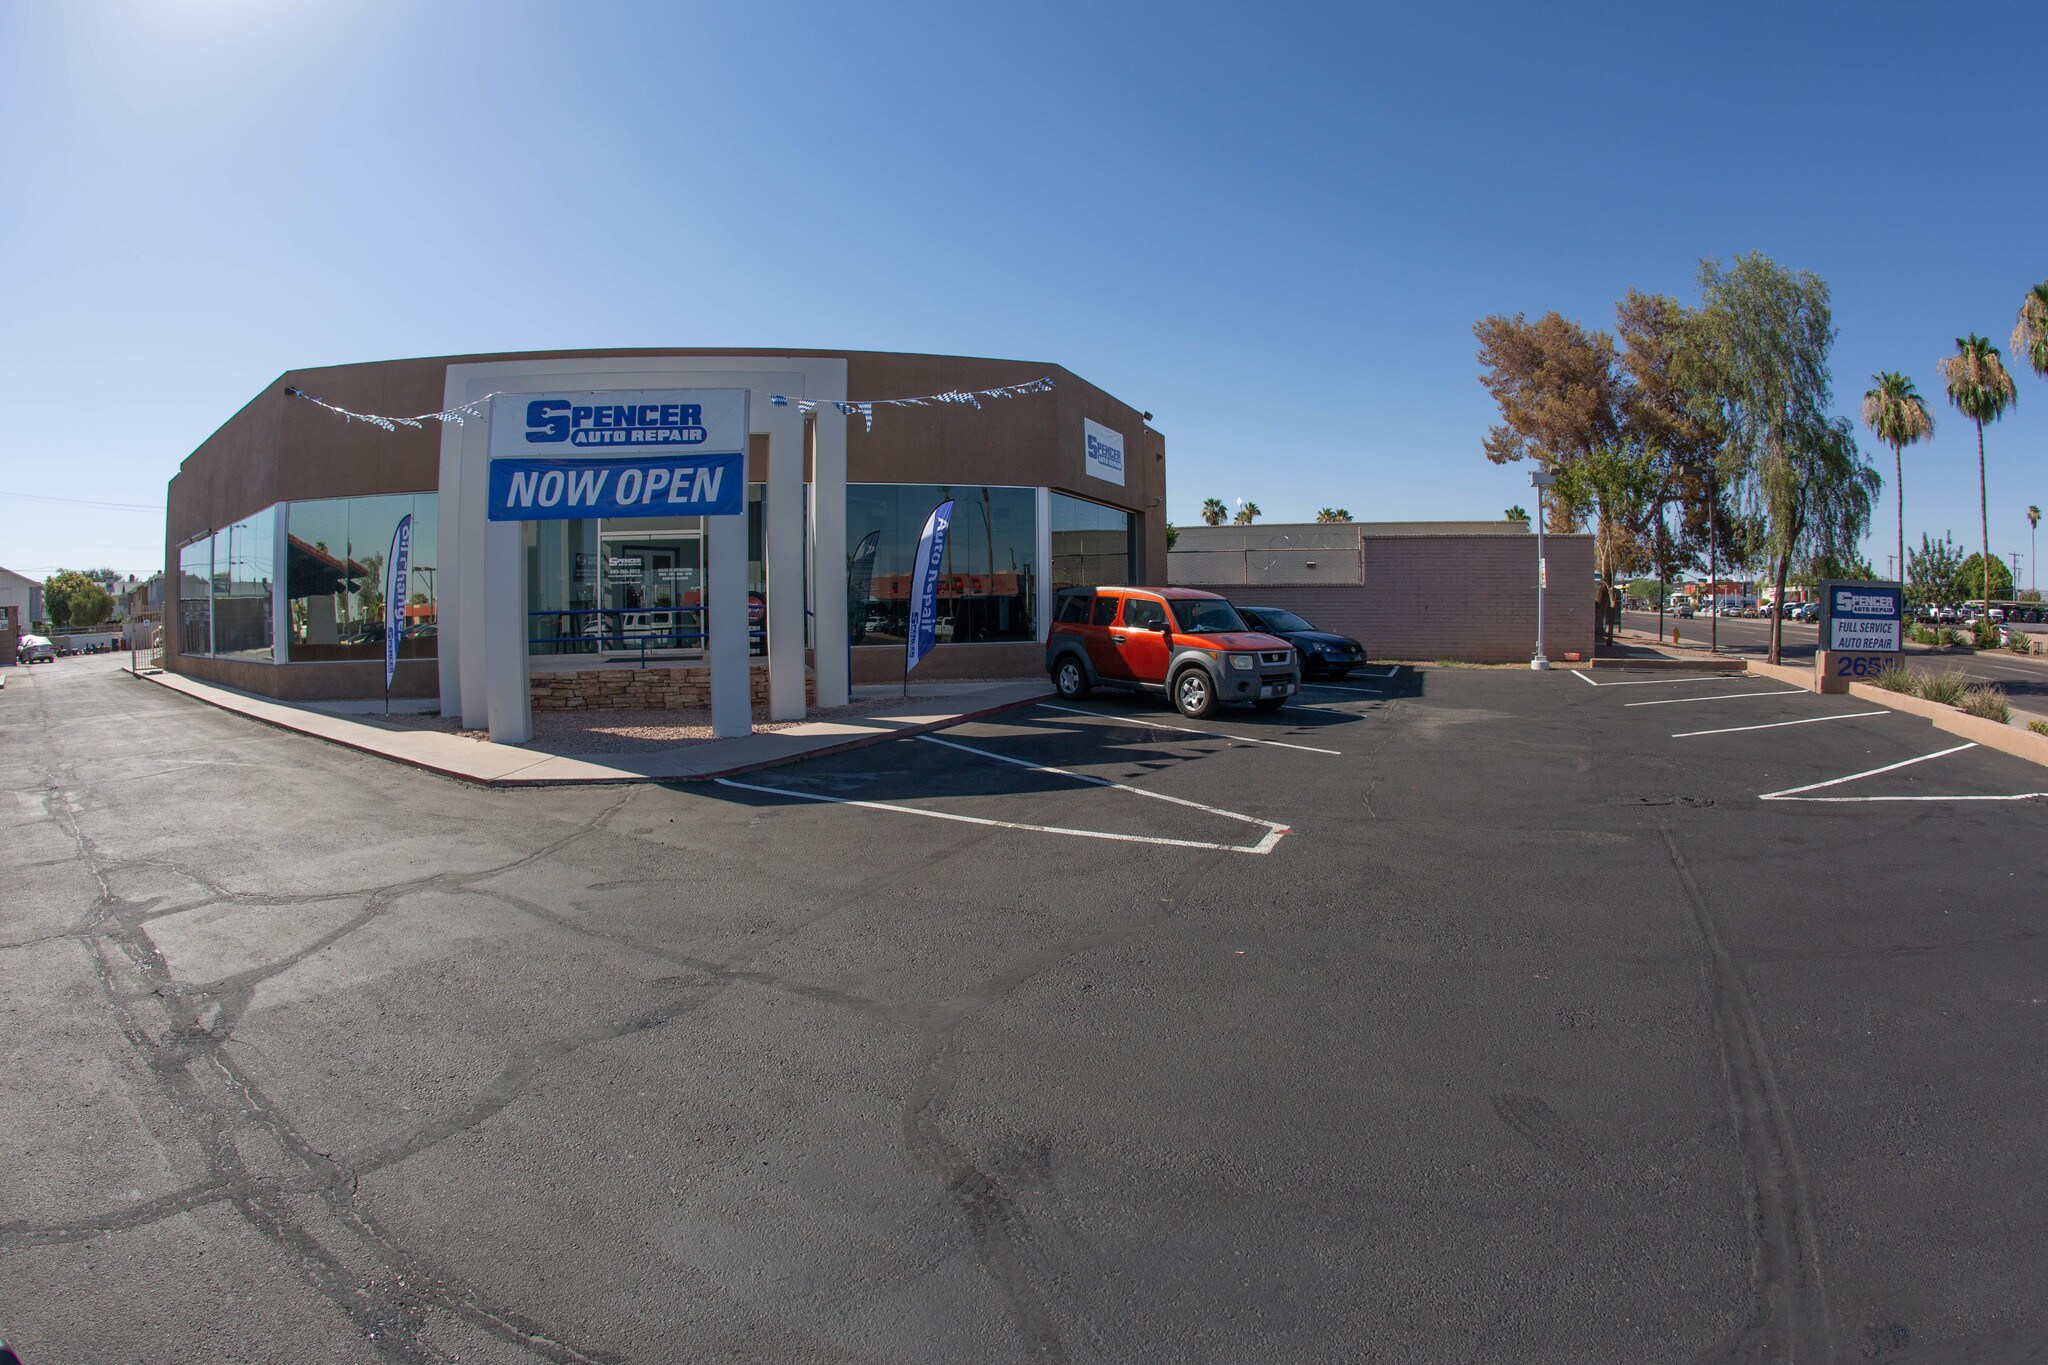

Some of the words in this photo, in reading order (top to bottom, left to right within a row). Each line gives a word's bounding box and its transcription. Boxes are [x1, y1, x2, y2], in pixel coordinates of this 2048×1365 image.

[526, 400, 702, 443] SPENCER
[575, 430, 626, 443] AUTO
[632, 428, 702, 442] REPAIR
[1088, 434, 1121, 461] SPENCER
[506, 470, 609, 508] NOW
[615, 467, 724, 506] OPEN
[931, 517, 949, 564] Auto
[1836, 592, 1893, 611] SPENCER
[1838, 622, 1857, 632] FULL
[1859, 622, 1892, 634] SERVICE
[1838, 638, 1861, 648] AUTO
[1863, 638, 1892, 649] REPAIR
